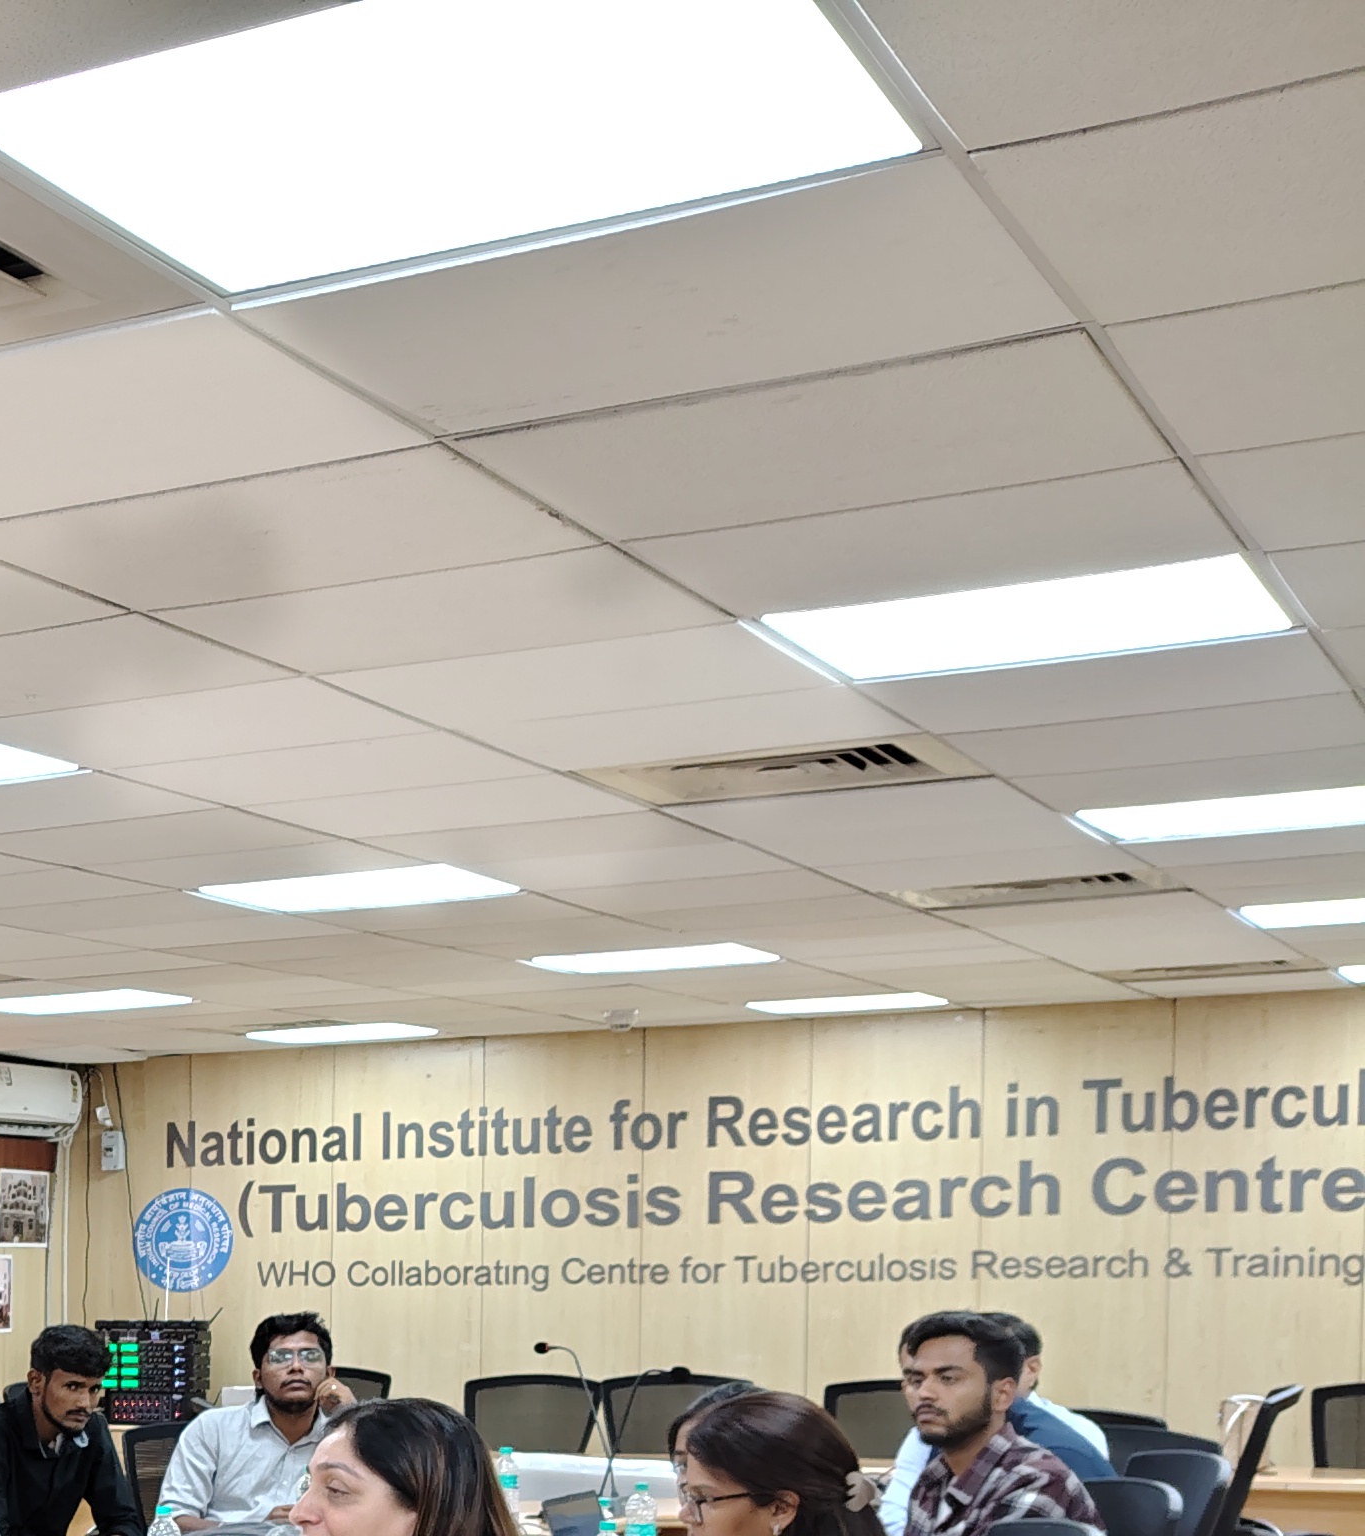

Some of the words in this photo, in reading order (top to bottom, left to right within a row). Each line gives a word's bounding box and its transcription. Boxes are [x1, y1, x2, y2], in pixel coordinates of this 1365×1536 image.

[166, 1112, 362, 1168] National
[382, 1104, 594, 1160] Institute
[609, 1099, 688, 1151] for
[706, 1085, 982, 1148] Research
[1006, 1082, 1059, 1138] in
[1082, 1068, 1365, 1134] Tubercul
[238, 1173, 682, 1238] (Tuberculosis
[707, 1160, 1061, 1225] Research
[1091, 1155, 1365, 1217] Centre
[257, 1260, 336, 1288] WHO
[347, 1259, 550, 1293] Collaborating
[561, 1256, 670, 1286] Centre
[679, 1255, 724, 1284] for
[734, 1252, 958, 1284] Tuberculosis
[971, 1247, 1149, 1281] Research
[1163, 1247, 1193, 1279] &
[1204, 1246, 1365, 1288] Training
